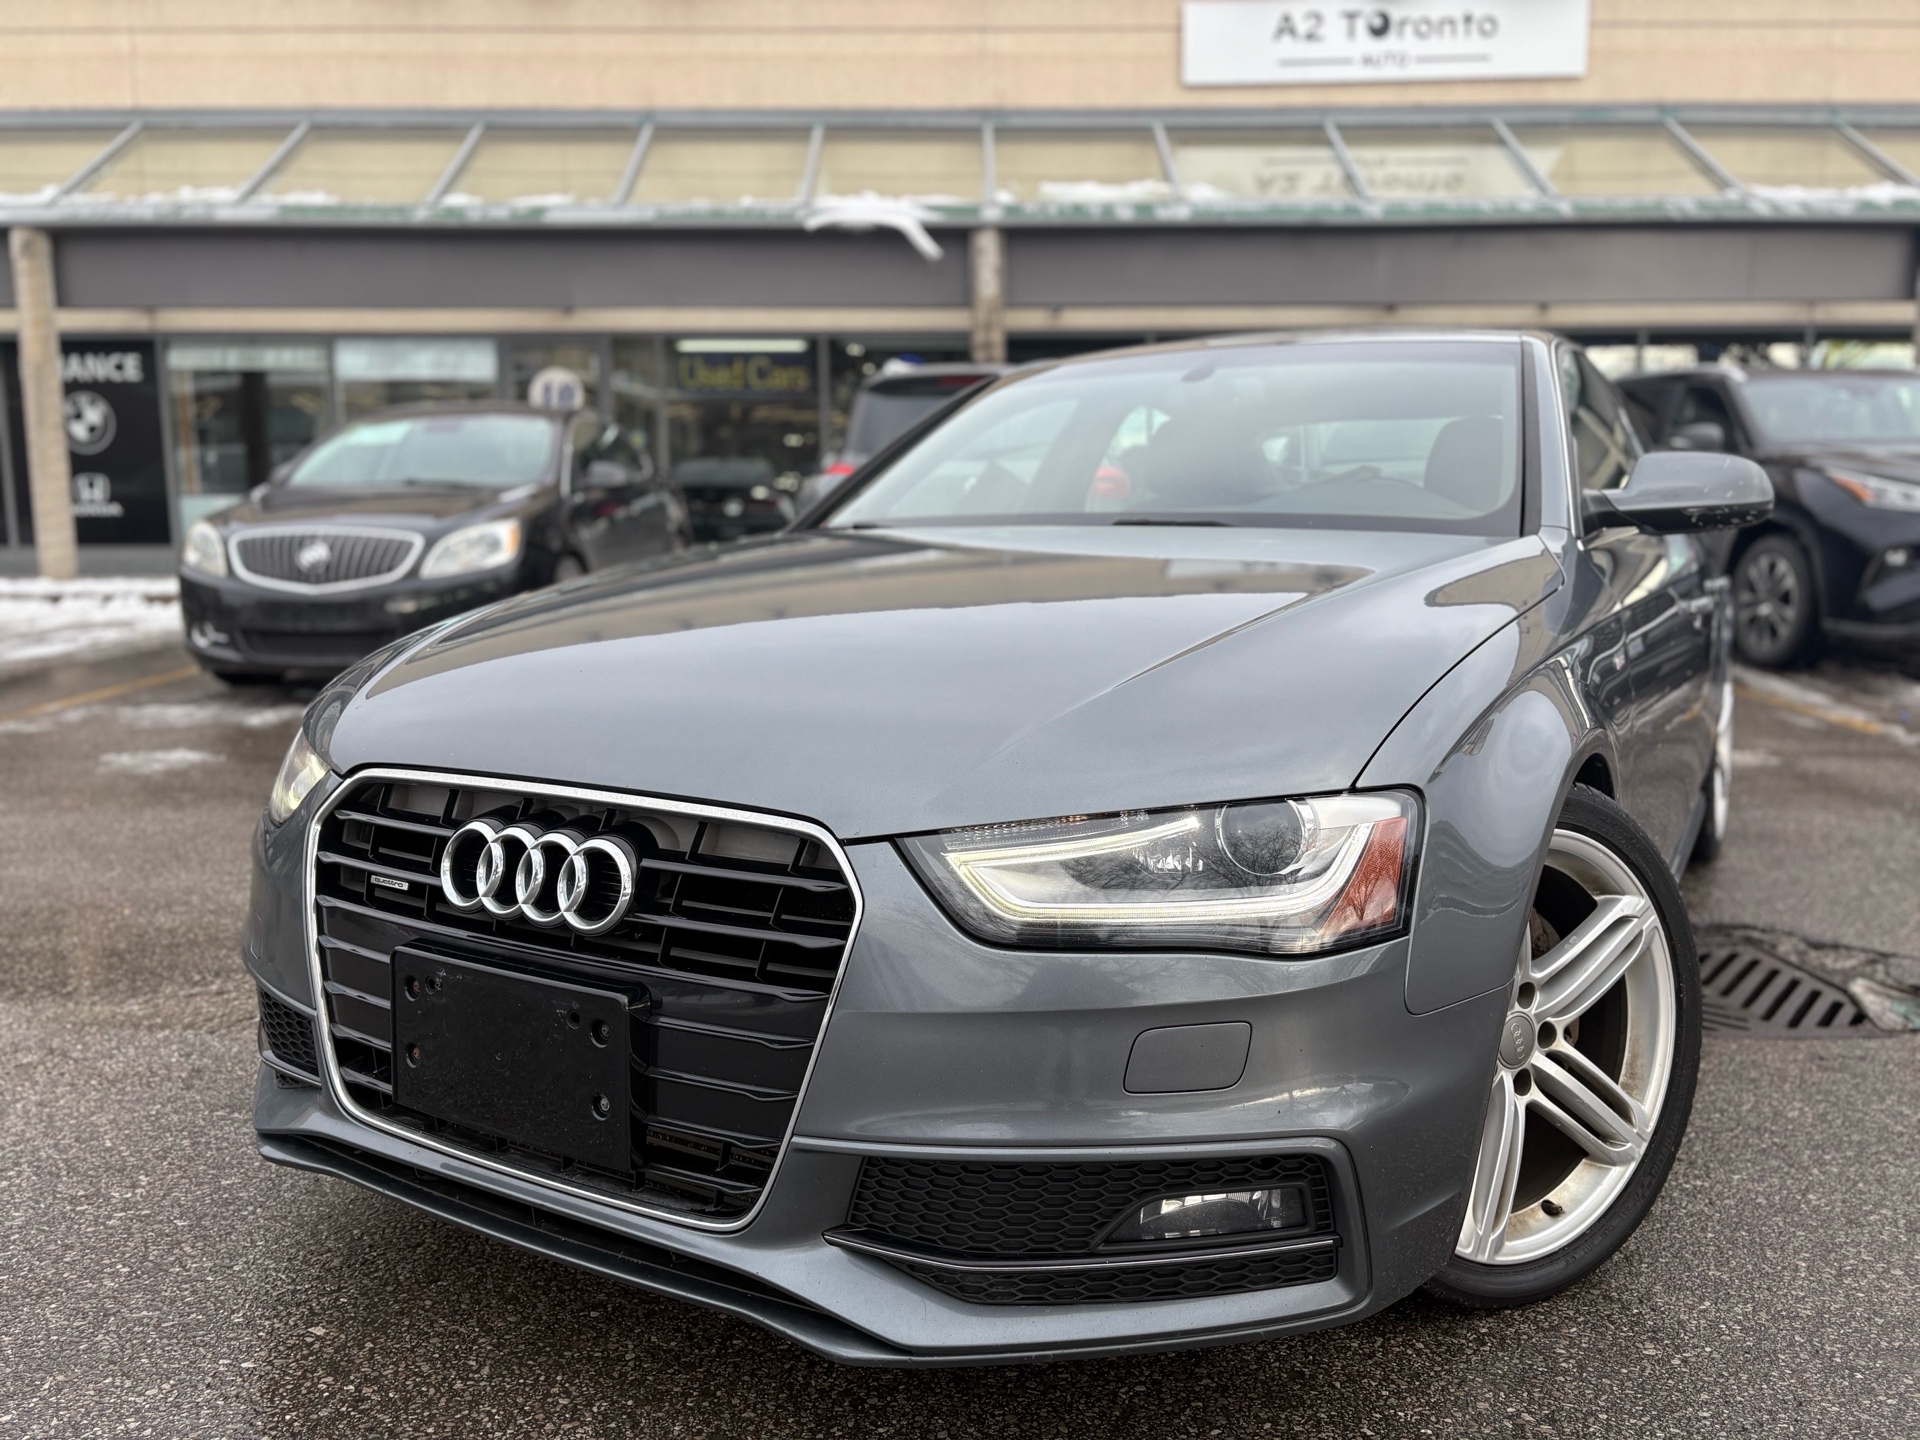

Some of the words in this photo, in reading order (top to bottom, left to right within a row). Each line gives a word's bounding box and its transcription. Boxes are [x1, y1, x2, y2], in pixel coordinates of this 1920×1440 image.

[1272, 9, 1326, 43] A2
[1340, 8, 1499, 42] Toronto
[375, 877, 404, 888] quattro
